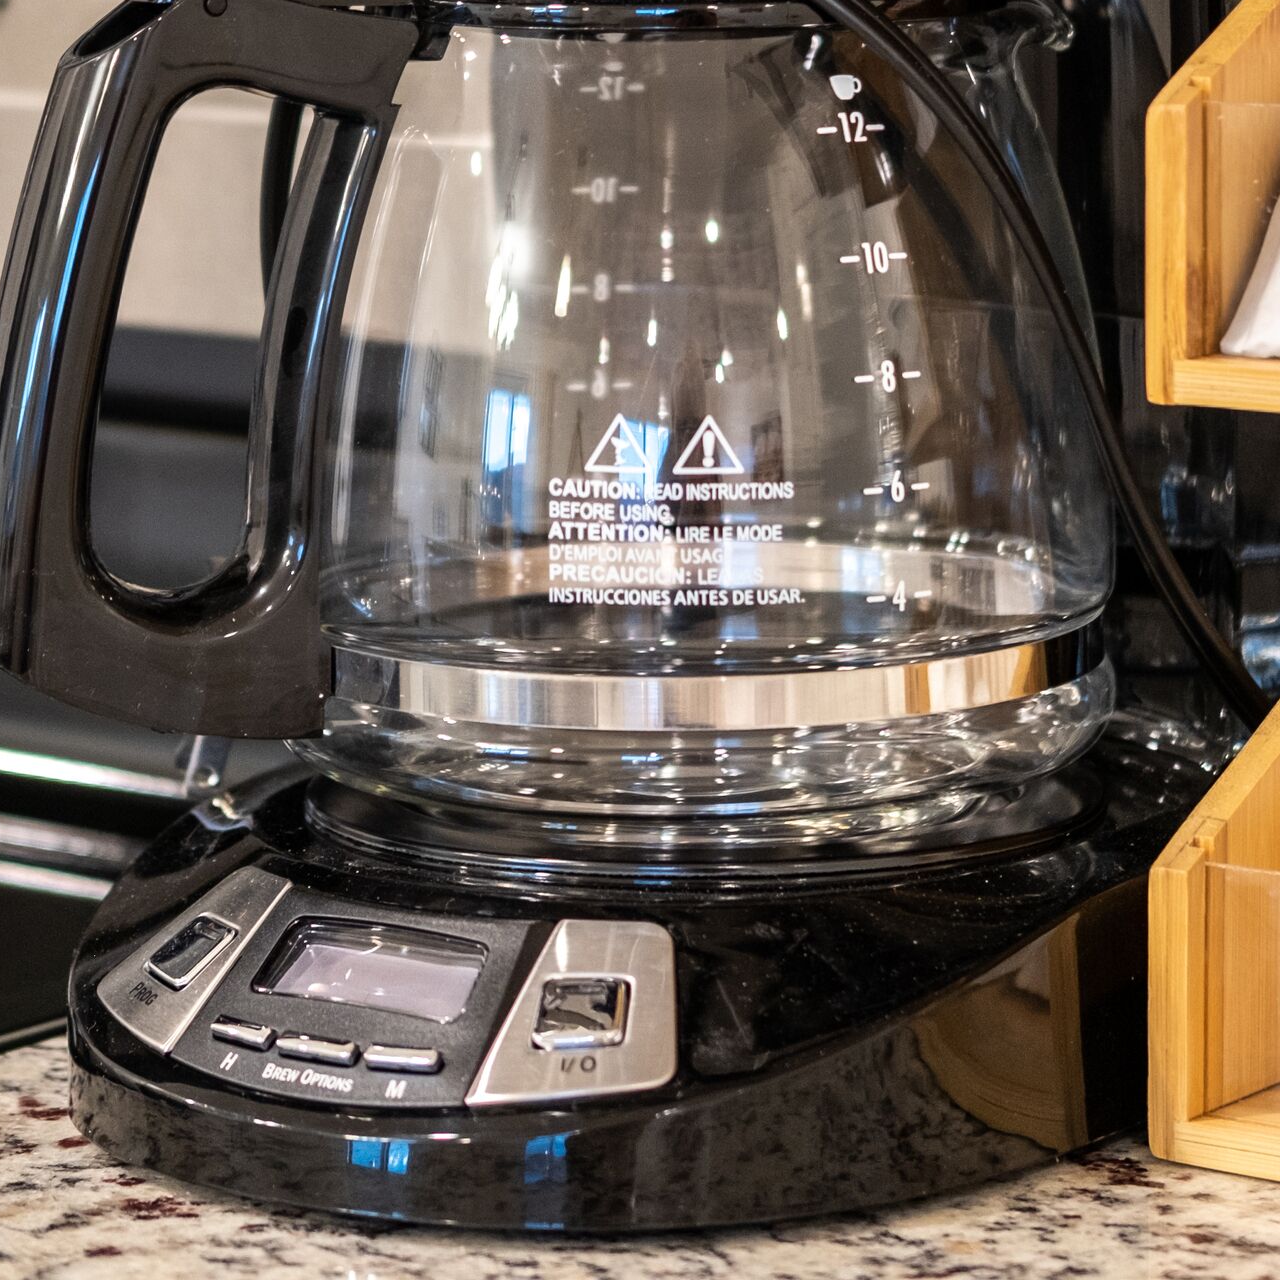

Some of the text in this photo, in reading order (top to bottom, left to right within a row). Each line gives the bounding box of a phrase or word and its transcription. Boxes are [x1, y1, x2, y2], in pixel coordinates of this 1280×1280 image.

[837, 111, 869, 144] 12
[861, 241, 890, 274] 10
[880, 359, 897, 393] 8
[548, 477, 795, 501] CAUTION: EAD INSTRUCTIONS
[890, 470, 906, 503] 6
[549, 500, 615, 519] BEFORE
[548, 522, 783, 543] ATTENTION: LIRE LE MODE
[680, 548, 733, 564] USAG
[548, 587, 806, 607] INSTRUCCIONES ANTES DE USAR.
[892, 580, 908, 612] 4
[129, 981, 159, 1007] PROG
[220, 1051, 407, 1099] H BREW OPTIONS M
